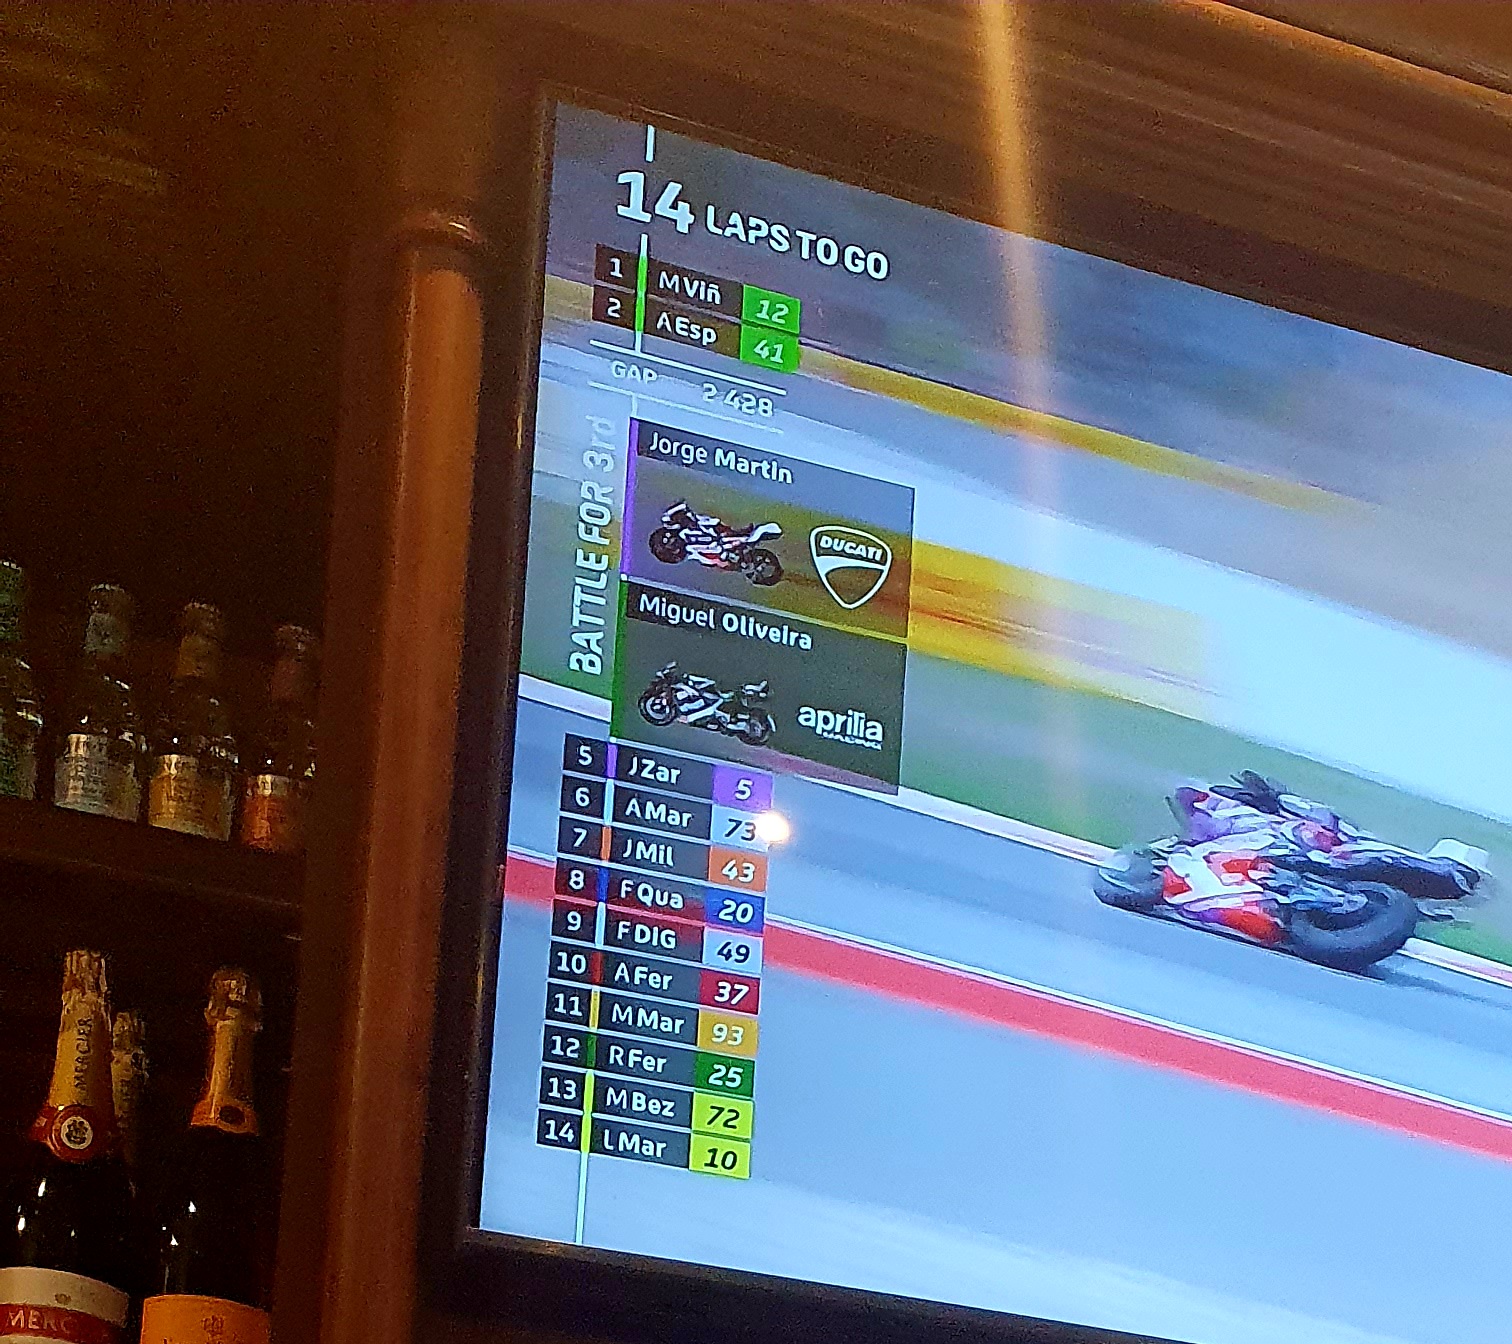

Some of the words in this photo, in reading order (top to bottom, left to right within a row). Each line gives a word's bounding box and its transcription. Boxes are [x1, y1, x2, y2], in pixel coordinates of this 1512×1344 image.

[616, 171, 695, 233] 14
[706, 204, 790, 253] LAPS
[796, 229, 839, 266] TO
[844, 244, 891, 281] GO
[609, 257, 624, 279] 1
[756, 299, 790, 325] 12
[607, 297, 622, 319] 2
[753, 339, 785, 364] 41
[611, 360, 657, 385] GAP
[582, 414, 617, 475] 3rd
[650, 431, 708, 466] Jorge
[713, 450, 794, 485] Martin
[576, 482, 614, 545] FOR
[819, 534, 883, 562] DUCATI
[567, 548, 608, 676] BATTLE
[638, 592, 716, 629] Miguel
[721, 615, 814, 651] Oliveira
[797, 704, 884, 744] aprilia
[577, 745, 593, 767] 5
[735, 779, 753, 801] 5
[575, 786, 591, 807] 6
[723, 817, 757, 841] 73
[572, 827, 588, 848] 7
[721, 858, 755, 883] 43
[568, 869, 585, 890] 8
[718, 900, 754, 925] 20
[566, 910, 582, 931] 9
[716, 940, 751, 963] 49
[556, 951, 586, 974] 10
[713, 981, 750, 1005] 37
[553, 993, 583, 1016] 11
[711, 1022, 744, 1046] 93
[550, 1034, 580, 1057] 12
[708, 1063, 743, 1087] 25
[547, 1077, 578, 1099] 13
[705, 1105, 740, 1129] 72
[544, 1119, 575, 1143] 14
[703, 1147, 738, 1170] 10
